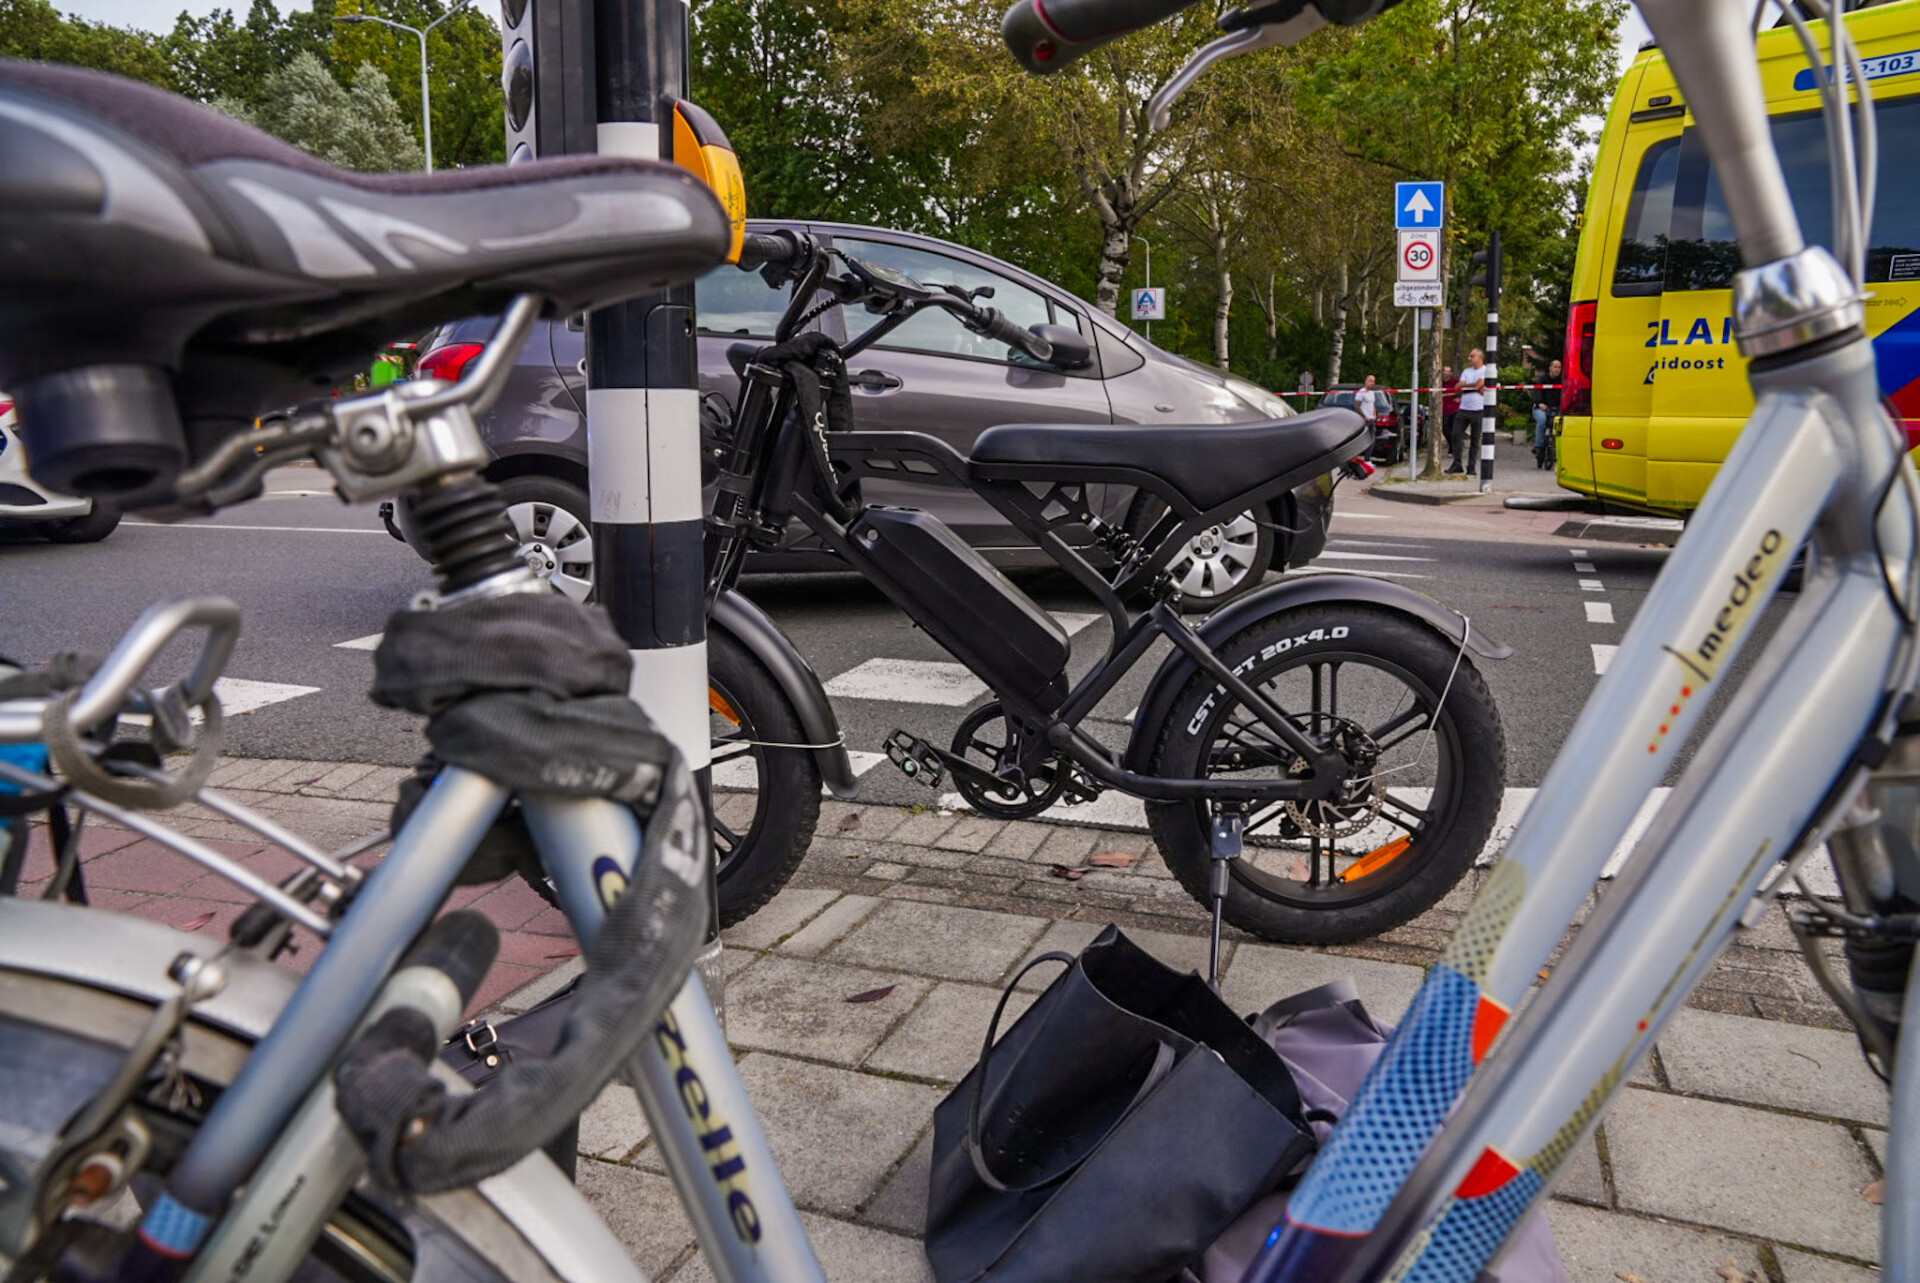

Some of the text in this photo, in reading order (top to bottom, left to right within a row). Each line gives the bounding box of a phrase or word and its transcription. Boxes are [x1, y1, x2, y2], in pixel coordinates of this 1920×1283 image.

[1410, 250, 1429, 262] 30
[1396, 284, 1441, 292] uitgezonderd
[1697, 529, 1782, 661] medeo
[1187, 693, 1215, 735] CST
[1261, 626, 1349, 661] 20x4.0
